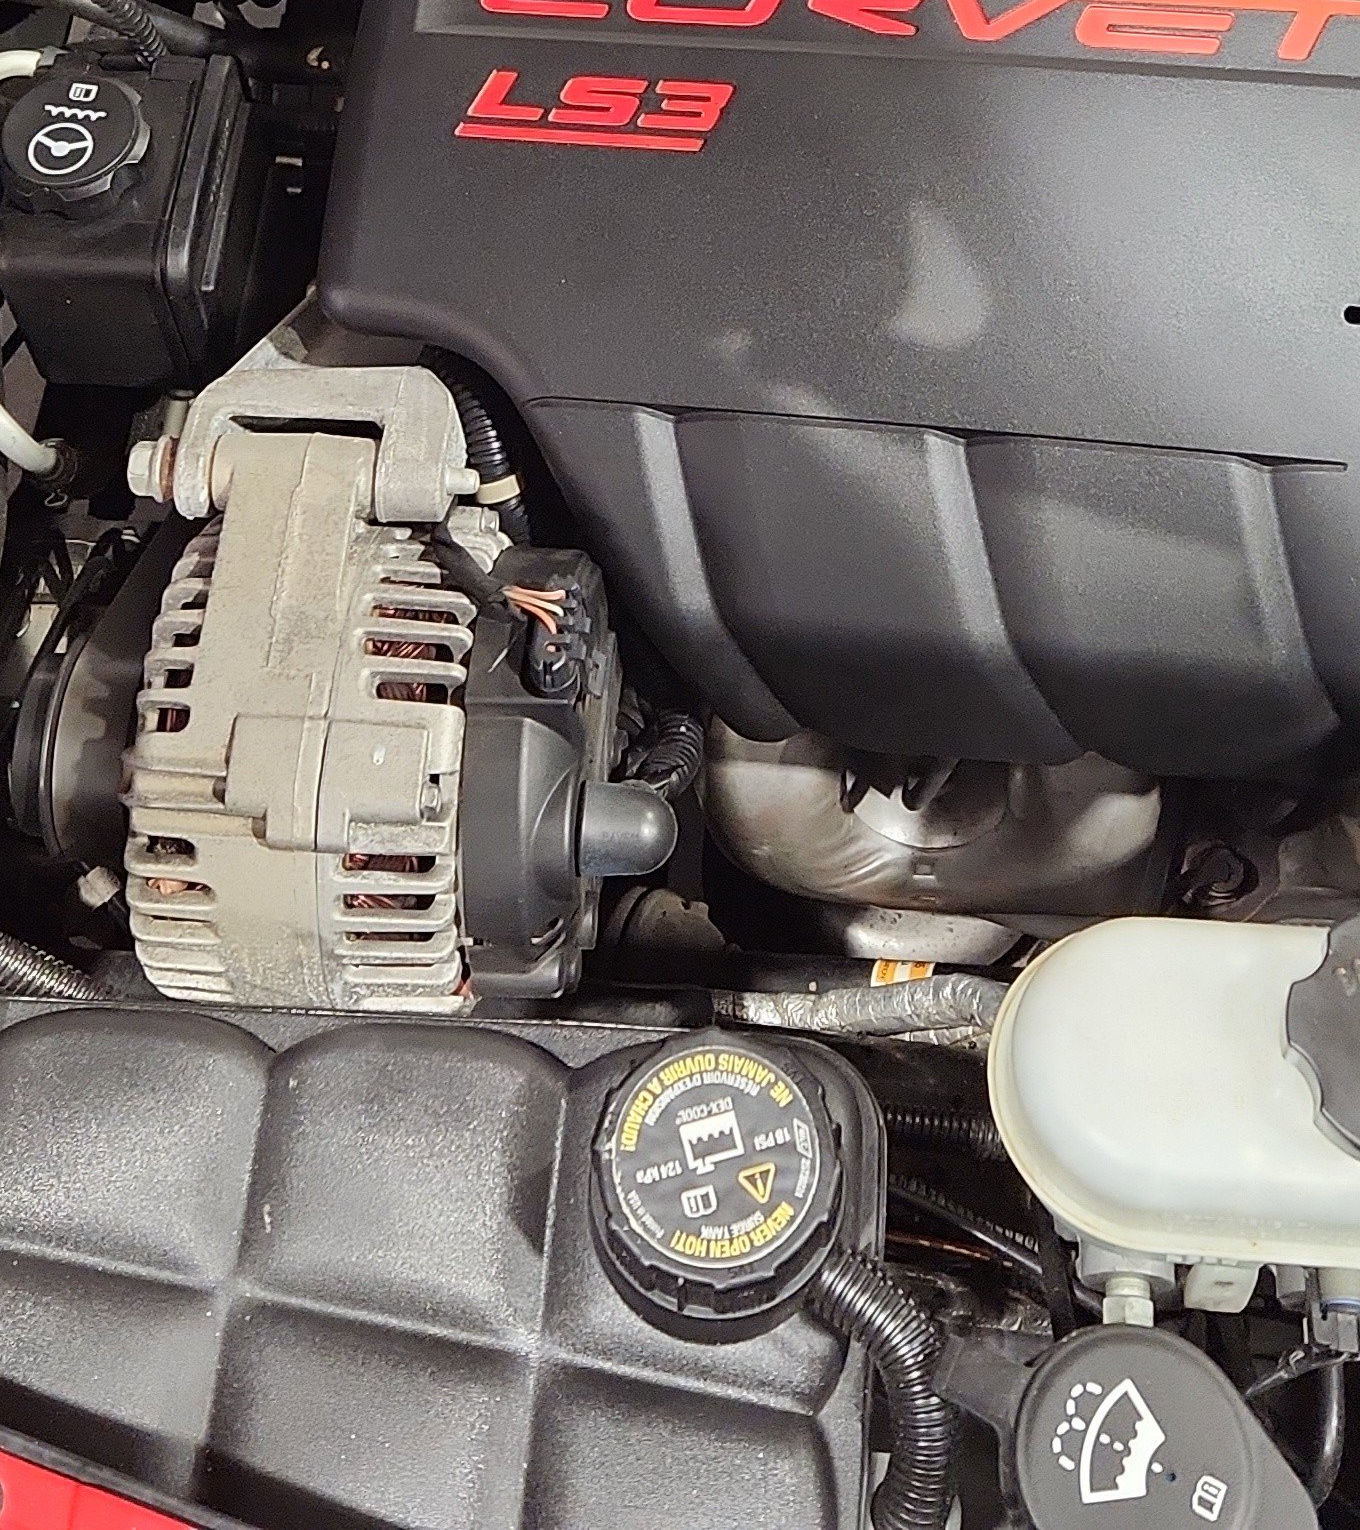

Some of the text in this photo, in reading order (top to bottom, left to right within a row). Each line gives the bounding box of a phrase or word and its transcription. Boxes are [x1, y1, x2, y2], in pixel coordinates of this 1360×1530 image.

[460, 67, 735, 138] LS3
[660, 1053, 716, 1087] OUVRIR
[718, 1053, 776, 1088] JAMAIS
[645, 1079, 663, 1096] A
[769, 1080, 794, 1108] NE
[619, 1089, 654, 1152] CHAUD!
[753, 1130, 776, 1152] PSI
[774, 1127, 791, 1145] 18
[660, 1159, 683, 1180] 124
[670, 1201, 795, 1259] NEVER OPEN HOT!
[700, 1224, 731, 1240] TANK
